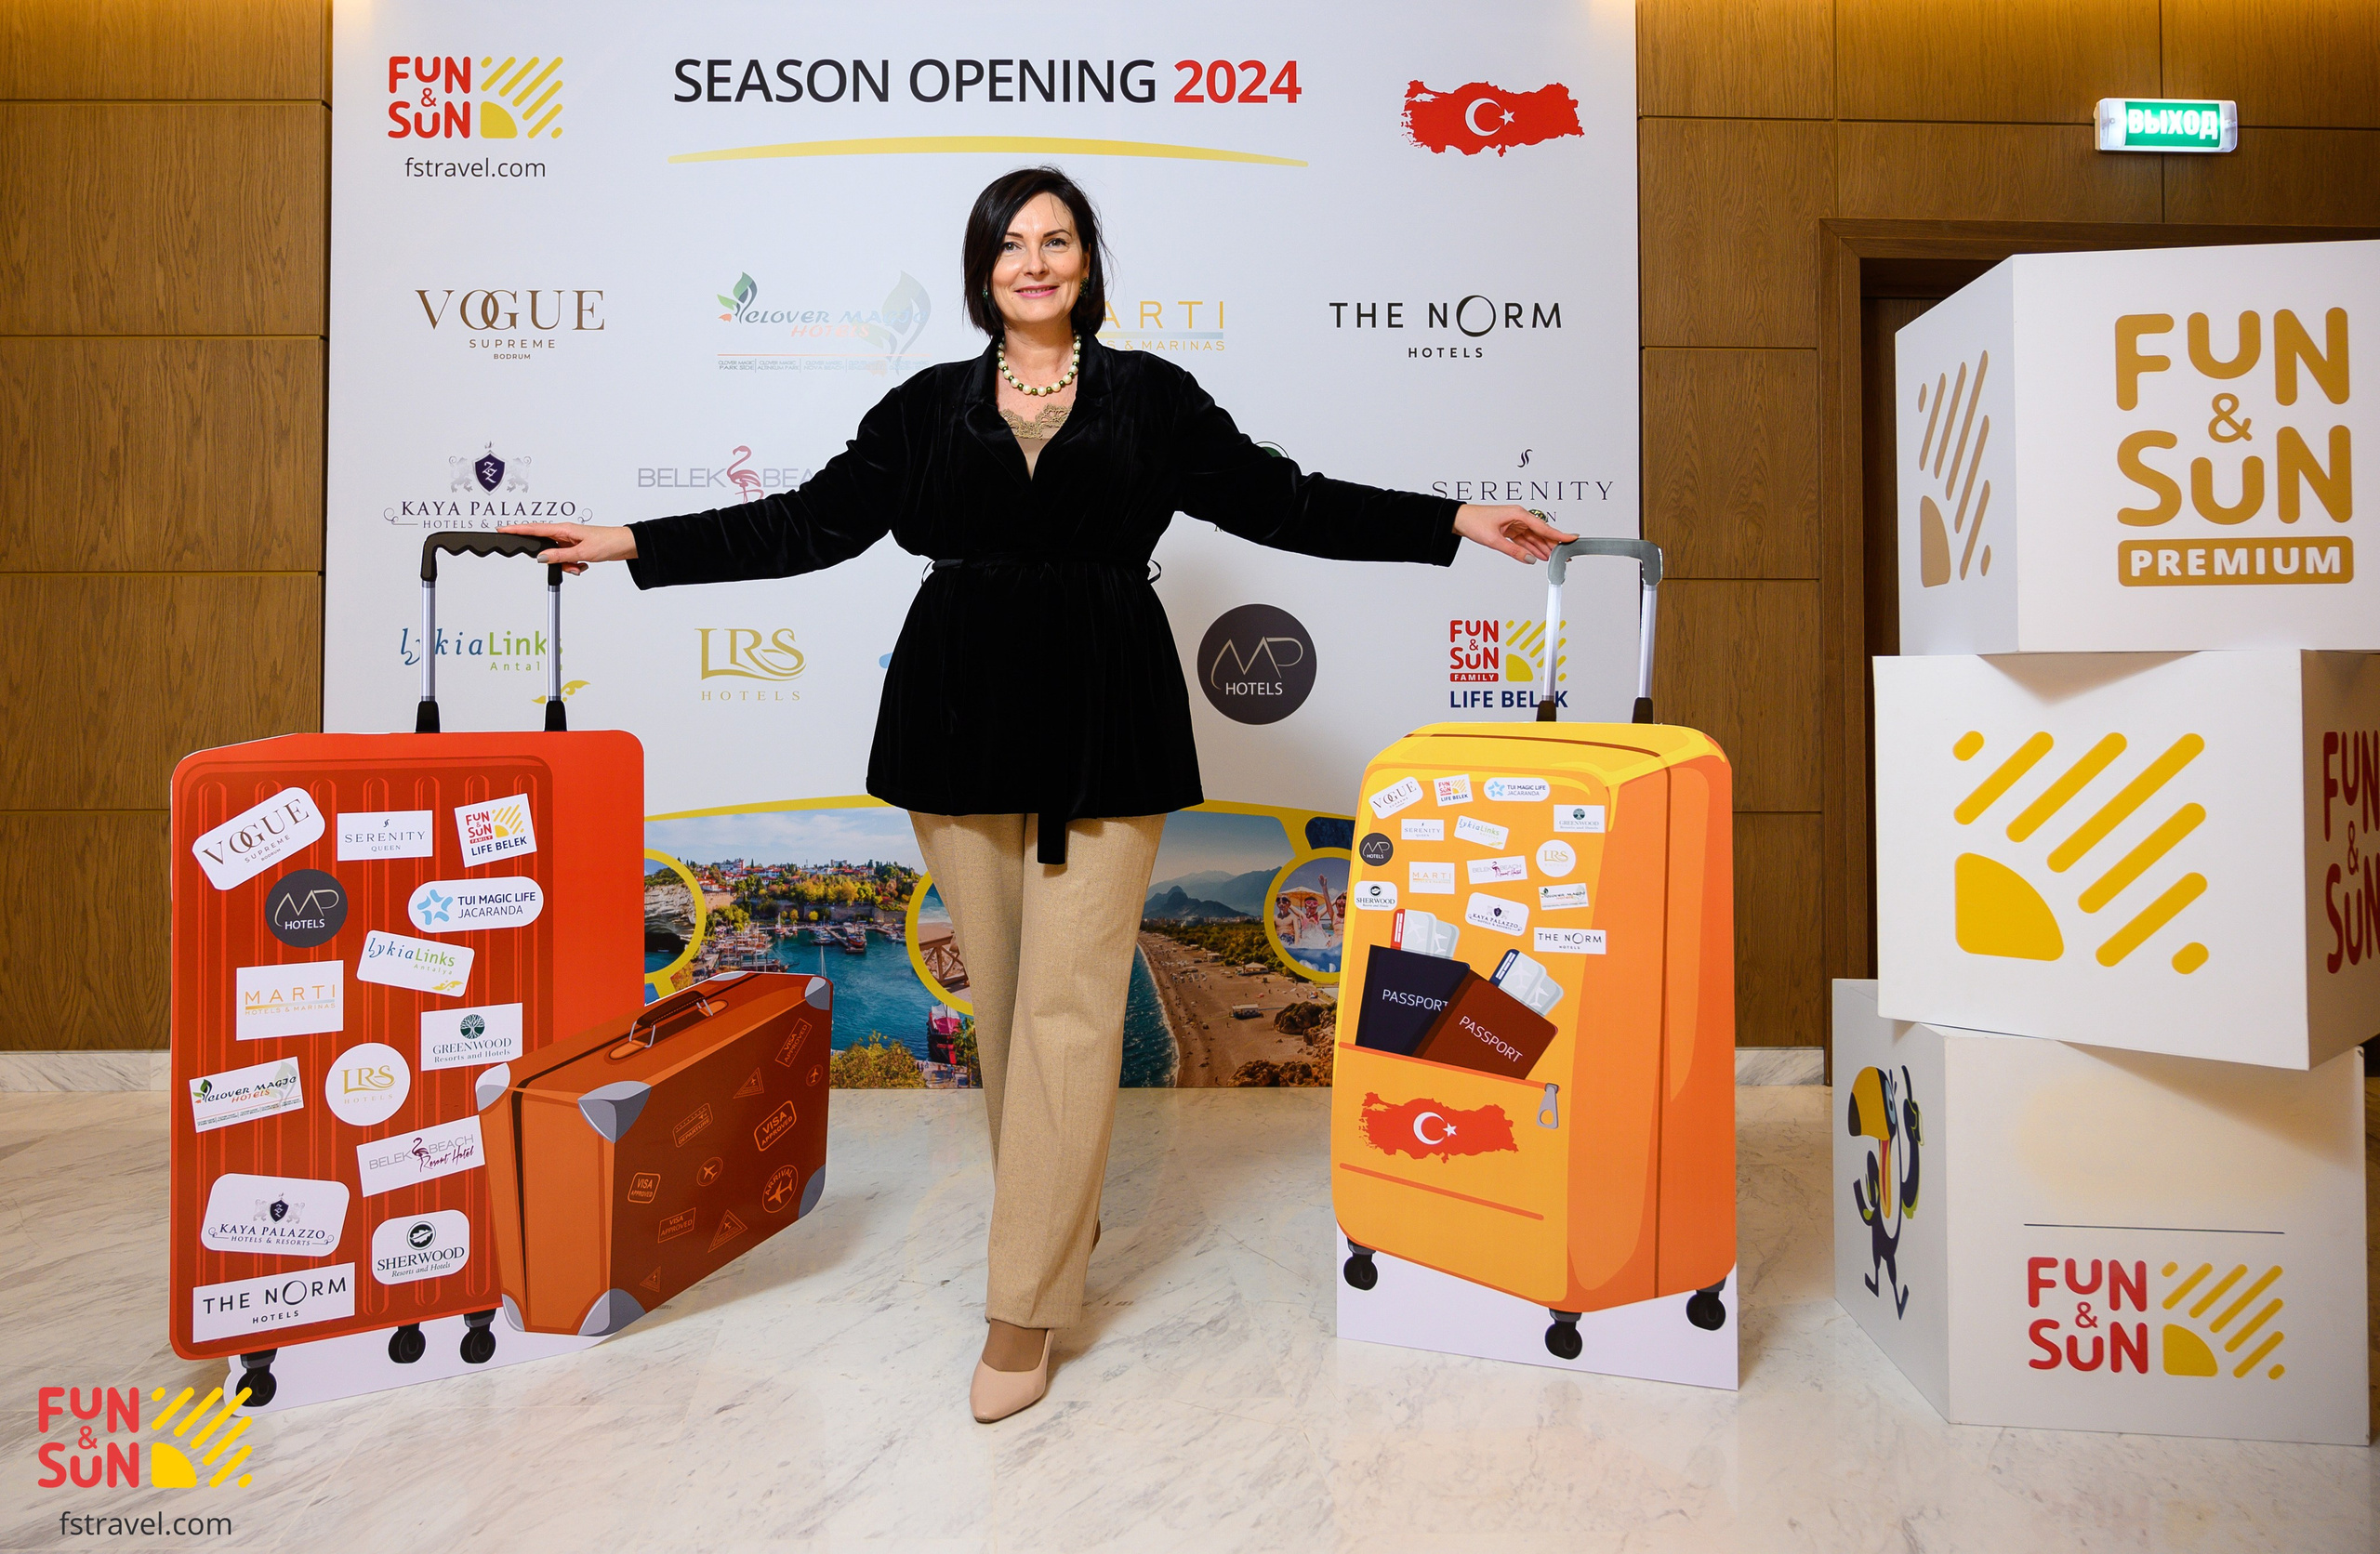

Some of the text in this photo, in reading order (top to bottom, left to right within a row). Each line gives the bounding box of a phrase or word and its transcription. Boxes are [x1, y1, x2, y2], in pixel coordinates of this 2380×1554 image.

[389, 56, 470, 94] FUN
[674, 59, 1302, 104] SEASON OPENING 2024
[421, 87, 437, 107] &
[388, 101, 470, 138] SUN
[2128, 109, 2218, 139] ВЫХОД
[404, 157, 546, 178] fstravel.com
[415, 289, 604, 330] VOGUE
[745, 310, 929, 323] CLOVER MAGIC
[1104, 300, 1223, 329] ARTI
[1329, 295, 1562, 337] THE NORM
[790, 325, 869, 337] HOTELS
[469, 339, 555, 349] SUPREME
[1125, 340, 1133, 350] &
[1142, 340, 1225, 351] MARINAS
[1408, 348, 1483, 358] HOTELS
[2114, 307, 2350, 412] FUN
[2208, 392, 2253, 443] &
[638, 468, 813, 488] BELEK BEA
[2117, 425, 2353, 527] SUN
[1432, 481, 1613, 500] SERENITY
[402, 501, 576, 516] KAYA PALAZZO
[423, 520, 473, 529] HOTELS
[481, 520, 490, 529] &
[2131, 546, 2341, 576] PREMIUM
[1450, 620, 1499, 643] FUN
[694, 627, 807, 681] LRS
[1469, 639, 1479, 651] &
[490, 661, 563, 671] Antal
[1210, 637, 1303, 690] MP
[1450, 647, 1499, 669] SUN
[701, 691, 800, 701] HOTELS
[1225, 682, 1283, 695] HOTELS
[1450, 691, 1568, 707] LIFE BELK
[1373, 781, 1417, 809] VOGUE
[2323, 731, 2380, 842] FUN
[466, 810, 490, 825] FUN
[202, 798, 310, 865] VOGUE
[345, 831, 425, 843] SERENITY
[468, 823, 492, 838] SUN
[471, 836, 491, 844] FAMILY
[245, 835, 290, 863] SUPREME
[261, 849, 281, 862] BODRUM
[471, 836, 527, 856] LIFE BELEK
[1363, 841, 1390, 857] MP
[1543, 849, 1569, 863] LRS
[2347, 820, 2360, 876] &
[1413, 871, 1451, 879] MARTI
[457, 891, 536, 905] TUI MAGIC LIFE
[1356, 897, 1395, 905] SHERWOOD
[274, 889, 339, 928] MP
[457, 905, 523, 919] JACARANDA
[2326, 852, 2380, 974] SUN
[284, 918, 325, 930] HOTELS
[1473, 913, 1488, 922] KAYA
[1490, 916, 1518, 928] PALAZZO
[1539, 932, 1602, 944] THE NORM
[414, 964, 453, 975] Antalya
[245, 984, 336, 1005] MARTI
[245, 1007, 281, 1016] HOTELS
[294, 1003, 336, 1011] MARINAS
[432, 1037, 512, 1055] GREENWOOD
[784, 1034, 797, 1050] VISA
[784, 1024, 808, 1062] APPROVED
[1459, 1015, 1523, 1063] PASSPORT
[434, 1048, 510, 1063] Resorts and Hotels
[207, 1076, 297, 1102] CLOVER MAGIC
[341, 1064, 396, 1095] LRS
[344, 1093, 393, 1104] HOTELS
[678, 1117, 710, 1144] DEPARTURE
[761, 1115, 793, 1145] APPROVED
[762, 1111, 787, 1134] VISA
[369, 1134, 474, 1170] BELEK BEACH
[417, 1145, 474, 1170] Resort Hotel
[637, 1179, 653, 1189] VISA
[765, 1168, 793, 1195] ARRIVAL
[661, 1218, 693, 1236] APPROVED
[669, 1215, 683, 1225] VISA
[219, 1223, 325, 1239] KAYA PALAZZO
[231, 1235, 262, 1244] HOTELS
[377, 1246, 465, 1271] SHERWOOD
[391, 1261, 451, 1277] Resorts and Hotels
[2028, 1257, 2148, 1311] FUN
[203, 1276, 346, 1314] THE NORM
[253, 1310, 299, 1324] HOTELS
[2075, 1301, 2098, 1329] &
[2029, 1319, 2149, 1374] SUN
